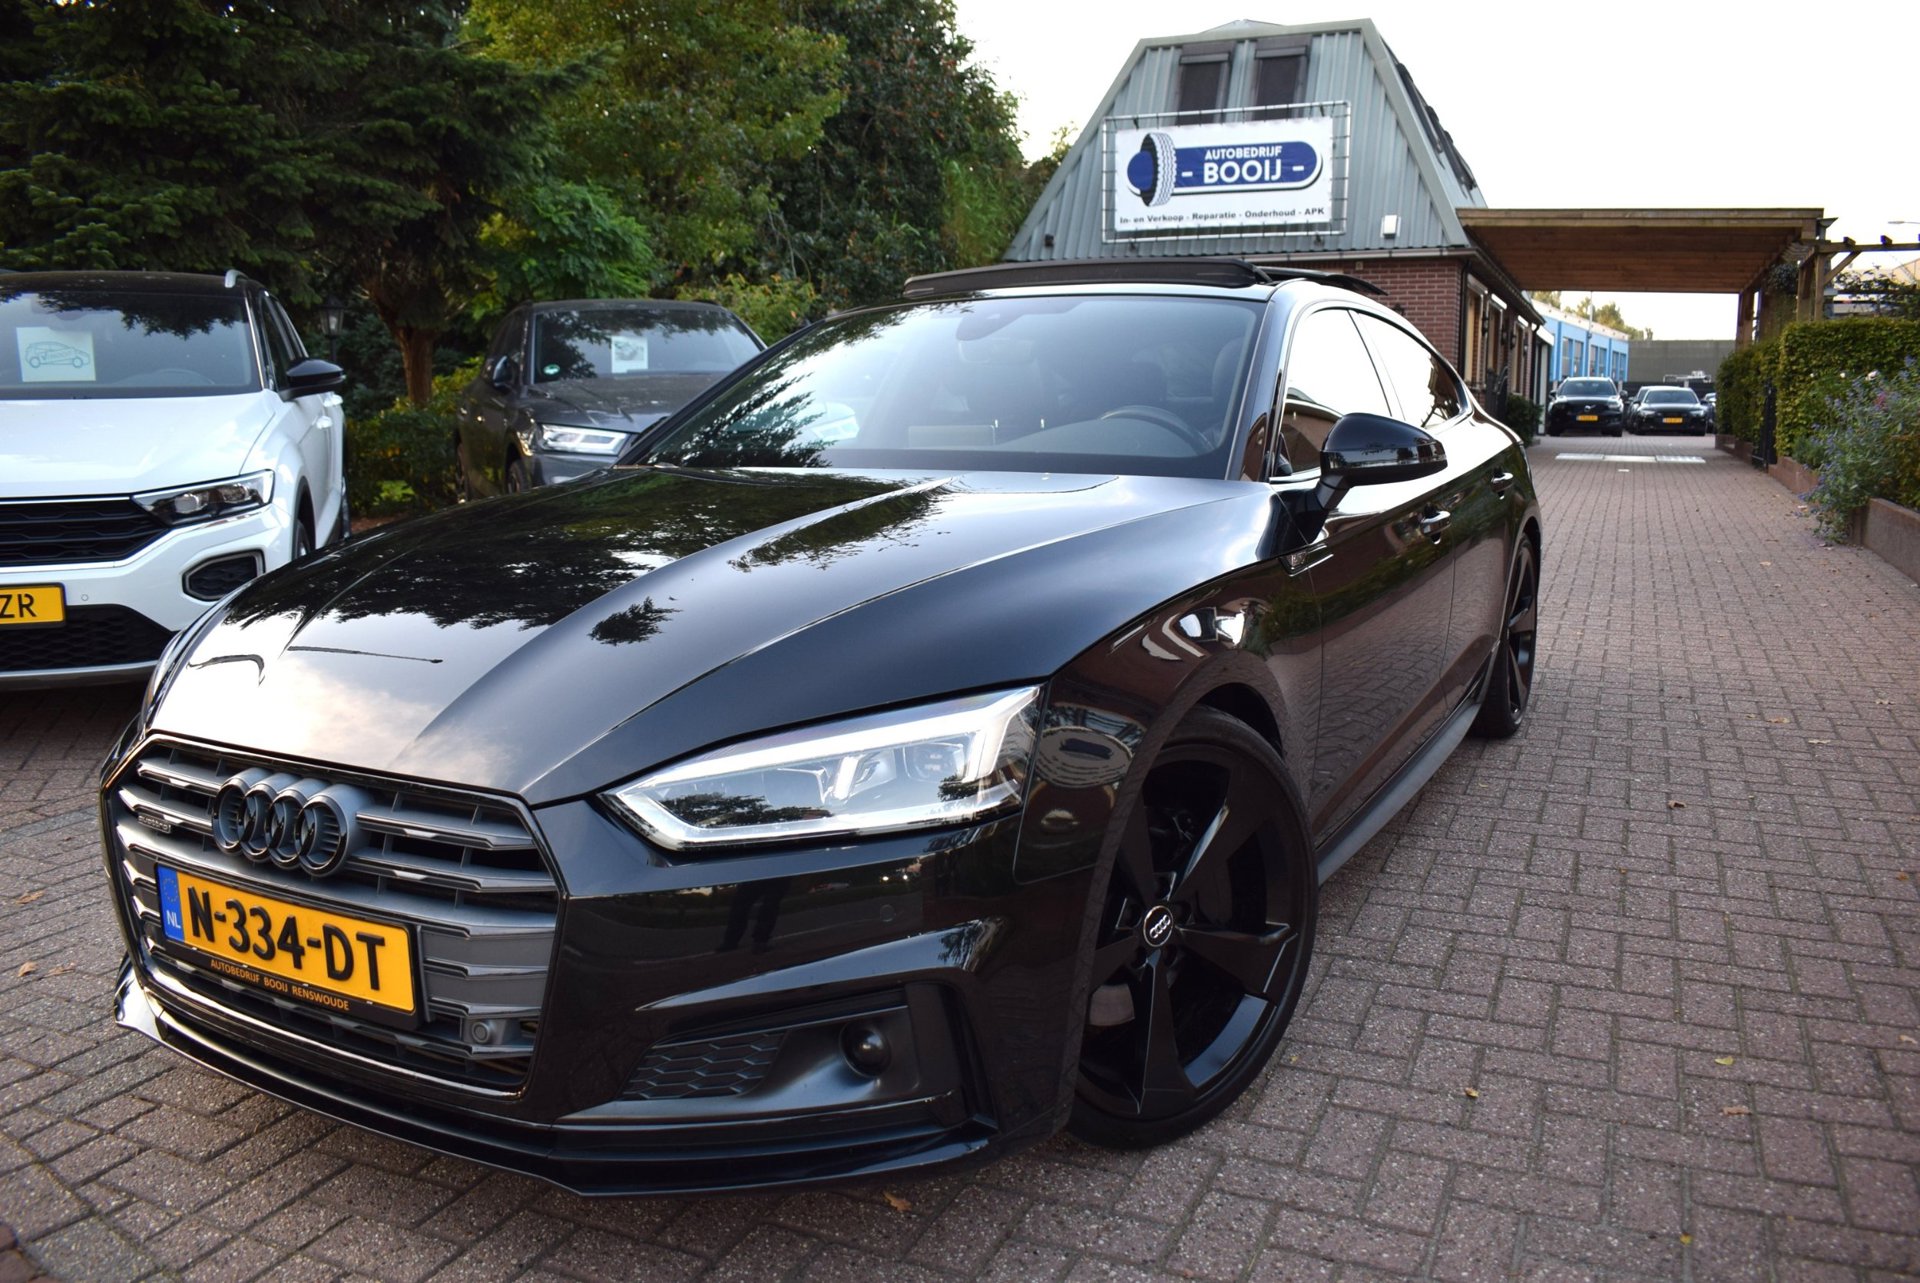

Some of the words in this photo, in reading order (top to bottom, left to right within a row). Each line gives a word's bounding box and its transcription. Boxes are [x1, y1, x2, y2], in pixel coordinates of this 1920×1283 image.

[1204, 146, 1283, 160] AUTOBEDRIJF
[1203, 159, 1282, 184] BOOIJ
[1147, 214, 1184, 223] Verkoop
[1192, 211, 1237, 221] Reparatie
[1245, 209, 1296, 219] Onderhoud
[1304, 207, 1325, 216] APK
[0, 593, 37, 618] ZR
[166, 910, 182, 929] NL
[187, 885, 386, 991] N-334-DT
[210, 959, 260, 983] AUTOBEDRIJF
[263, 976, 289, 992] BOOIJ
[291, 985, 351, 1011] RENSWOUDE
